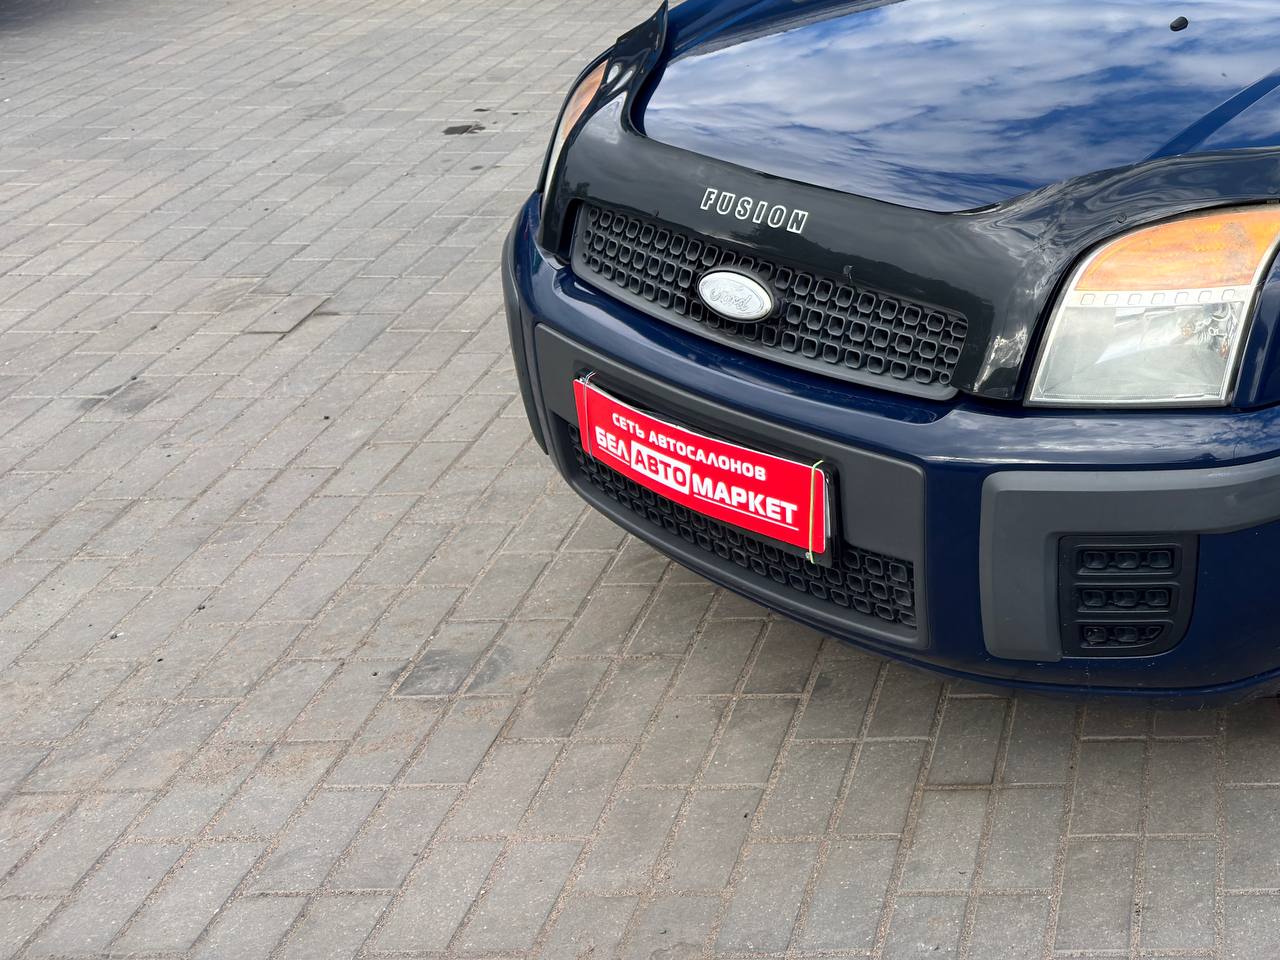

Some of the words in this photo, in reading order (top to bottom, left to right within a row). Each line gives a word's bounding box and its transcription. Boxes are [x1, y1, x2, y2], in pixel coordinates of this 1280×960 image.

[700, 187, 809, 234] FUSION
[709, 288, 753, 311] Ford
[612, 412, 645, 439] СЕТЬ
[648, 429, 767, 481] АВТОСАЛОНОВ
